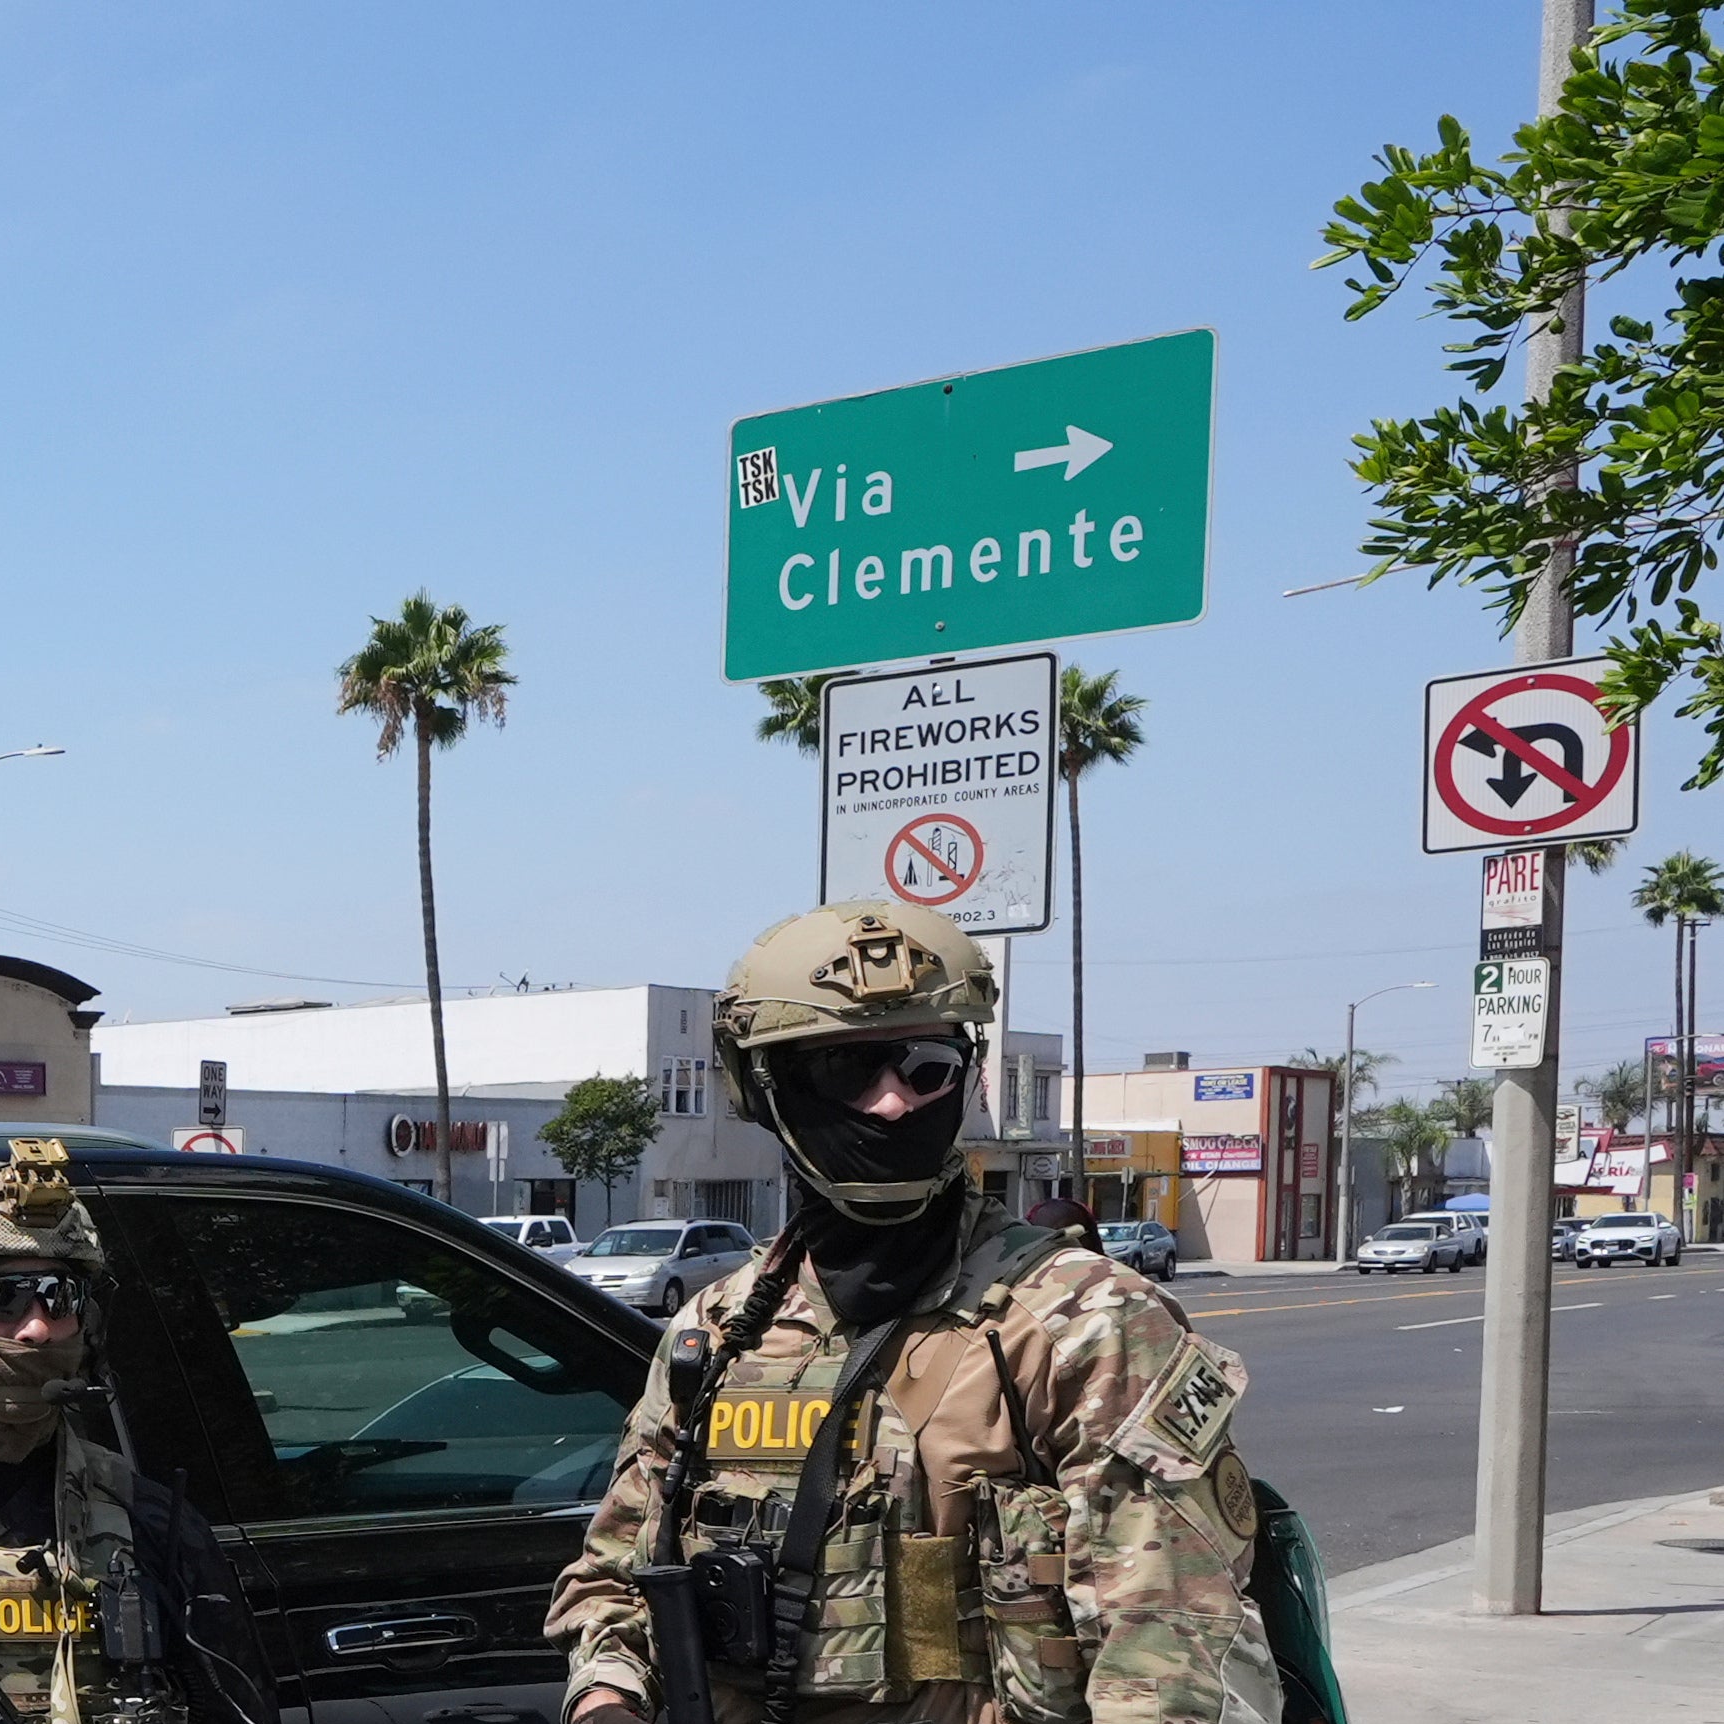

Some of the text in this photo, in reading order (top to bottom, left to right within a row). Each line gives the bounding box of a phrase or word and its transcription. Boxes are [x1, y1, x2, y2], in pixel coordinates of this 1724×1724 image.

[738, 450, 775, 481] TSK
[741, 476, 779, 506] TSK
[783, 463, 893, 529] Via
[778, 508, 1144, 611] Clemente
[902, 679, 975, 711] ALL
[838, 709, 1041, 757] FIREWORKS
[836, 751, 1041, 797] PROHIBITED
[836, 782, 1040, 815] IN UNINCORPORATED COUNTY AREAS
[1486, 852, 1541, 896] PARE
[1480, 965, 1542, 994] 2 HOUR
[1478, 994, 1542, 1016] PARKING
[1482, 1024, 1493, 1042] 7
[203, 1066, 224, 1082] ONE
[203, 1084, 224, 1100] WAY
[1182, 1135, 1259, 1151] SMOG CHECK
[1182, 1159, 1259, 1171] OIL CHANGE
